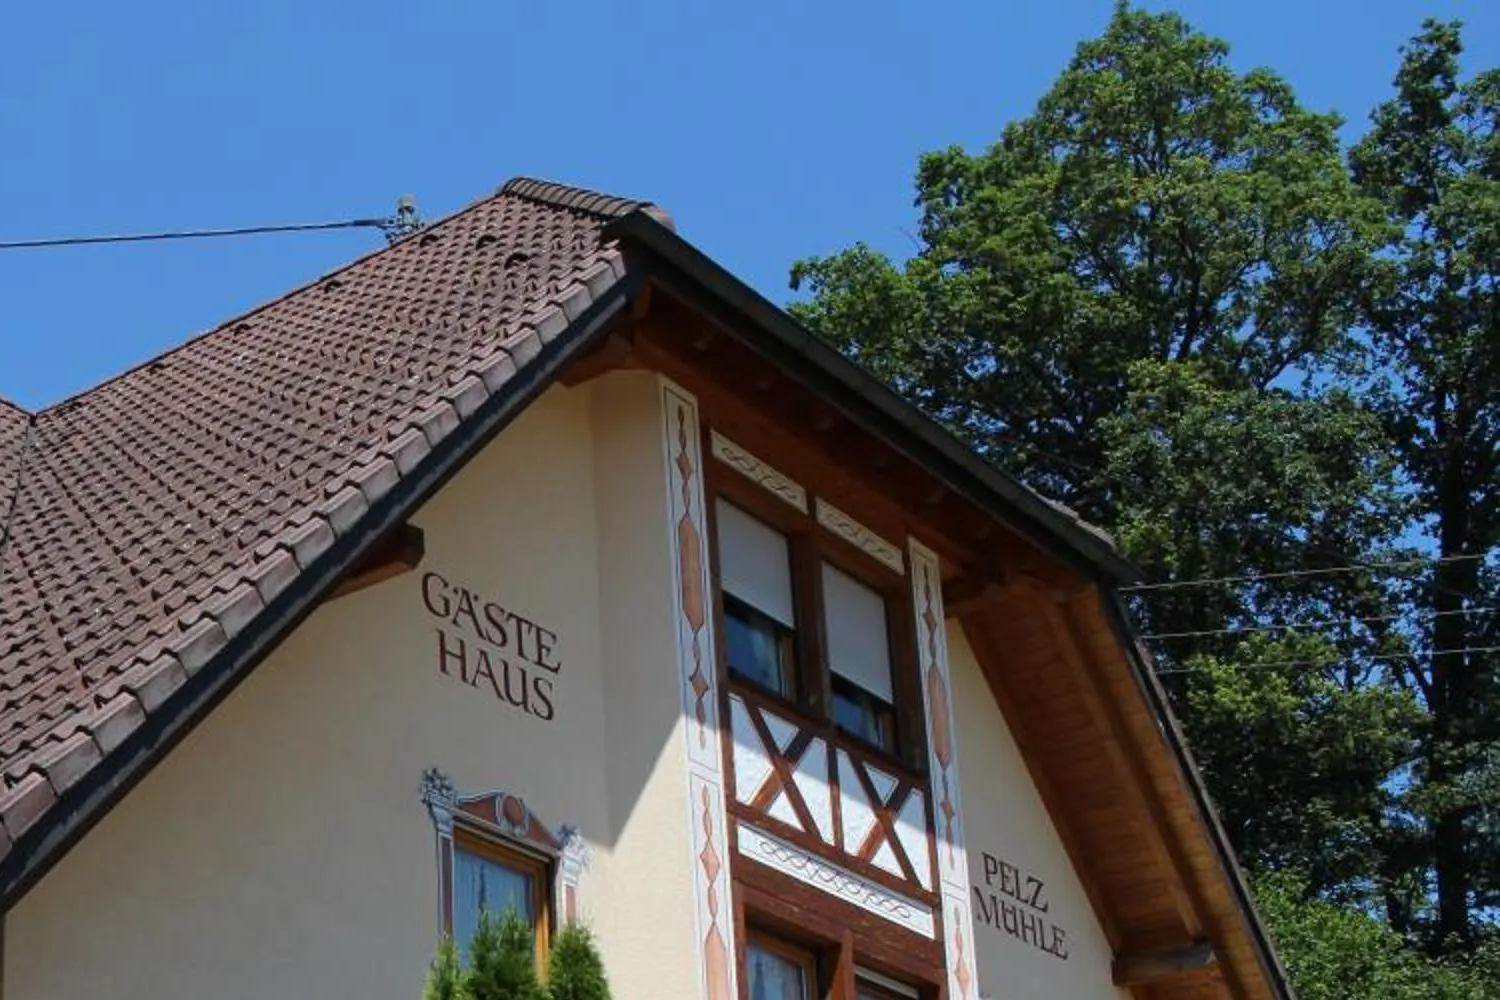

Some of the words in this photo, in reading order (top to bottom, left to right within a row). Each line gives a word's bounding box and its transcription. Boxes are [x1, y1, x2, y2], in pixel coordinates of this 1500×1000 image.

[421, 571, 561, 674] GÄSTE
[436, 627, 554, 720] HAUS
[973, 886, 1068, 960] MÜHLE
[982, 852, 1048, 913] PELZ
